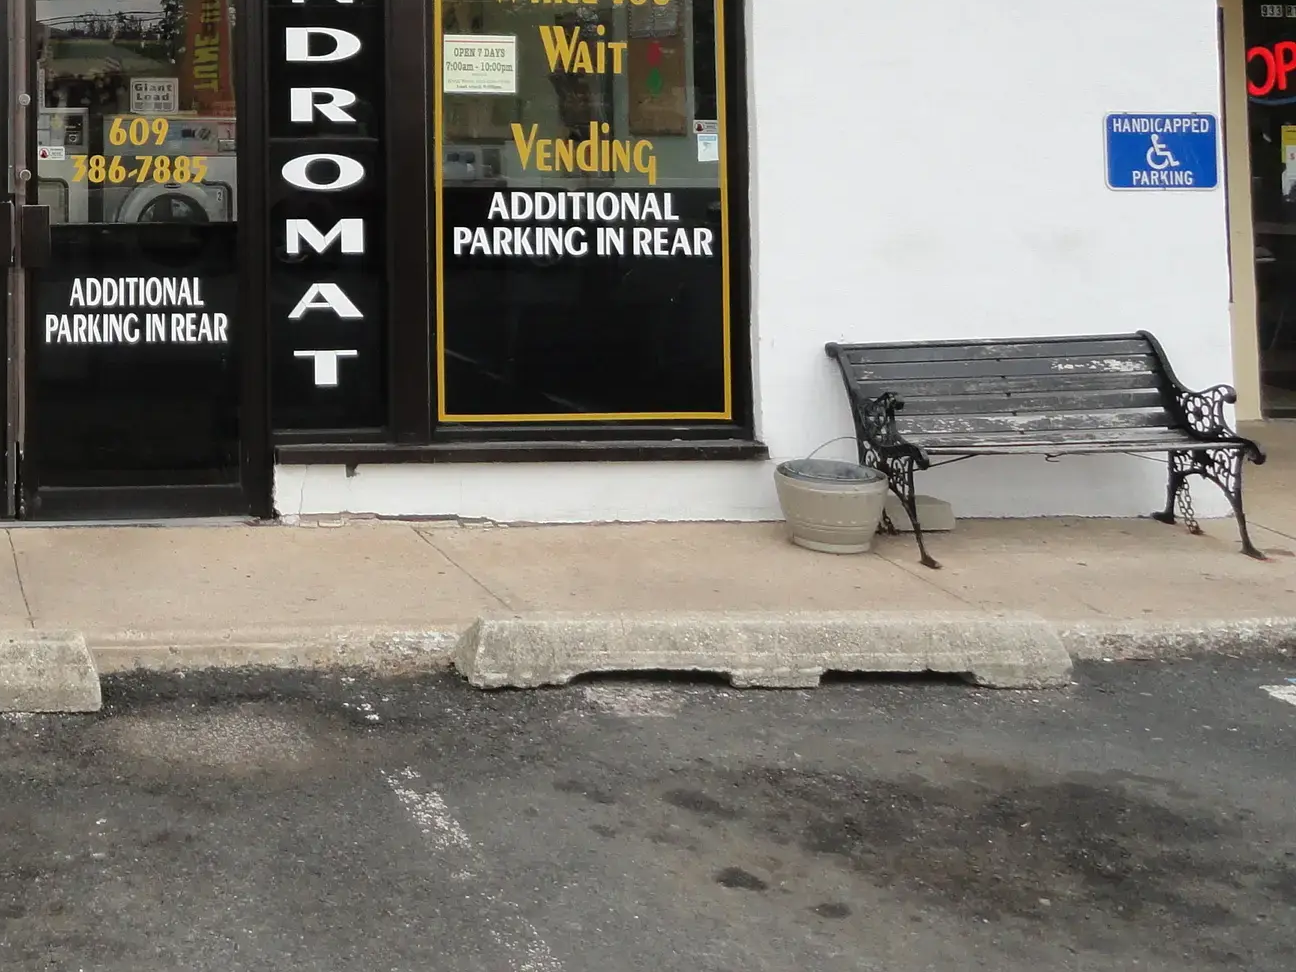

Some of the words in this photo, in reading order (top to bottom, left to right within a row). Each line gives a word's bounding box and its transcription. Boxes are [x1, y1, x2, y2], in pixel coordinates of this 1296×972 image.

[453, 47, 476, 57] OPEN
[477, 48, 482, 57] 7
[484, 48, 506, 58] DAYS
[445, 61, 474, 71] 7:00am
[481, 62, 513, 74] 10:00pm
[134, 83, 172, 92] Giant
[136, 92, 170, 101] Load
[109, 117, 169, 147] 609
[1112, 118, 1209, 133] HANDICAPPED
[71, 155, 209, 183] 386-7885
[1132, 171, 1193, 186] PARKING
[488, 192, 679, 220] ADDITIONAL
[453, 227, 588, 256] PARKING
[597, 228, 624, 255] IN
[633, 228, 713, 256] REAR
[69, 277, 204, 307] ADDITIONAL
[45, 313, 139, 343] PARKING
[145, 314, 166, 343] IN
[171, 312, 228, 342] REAR
